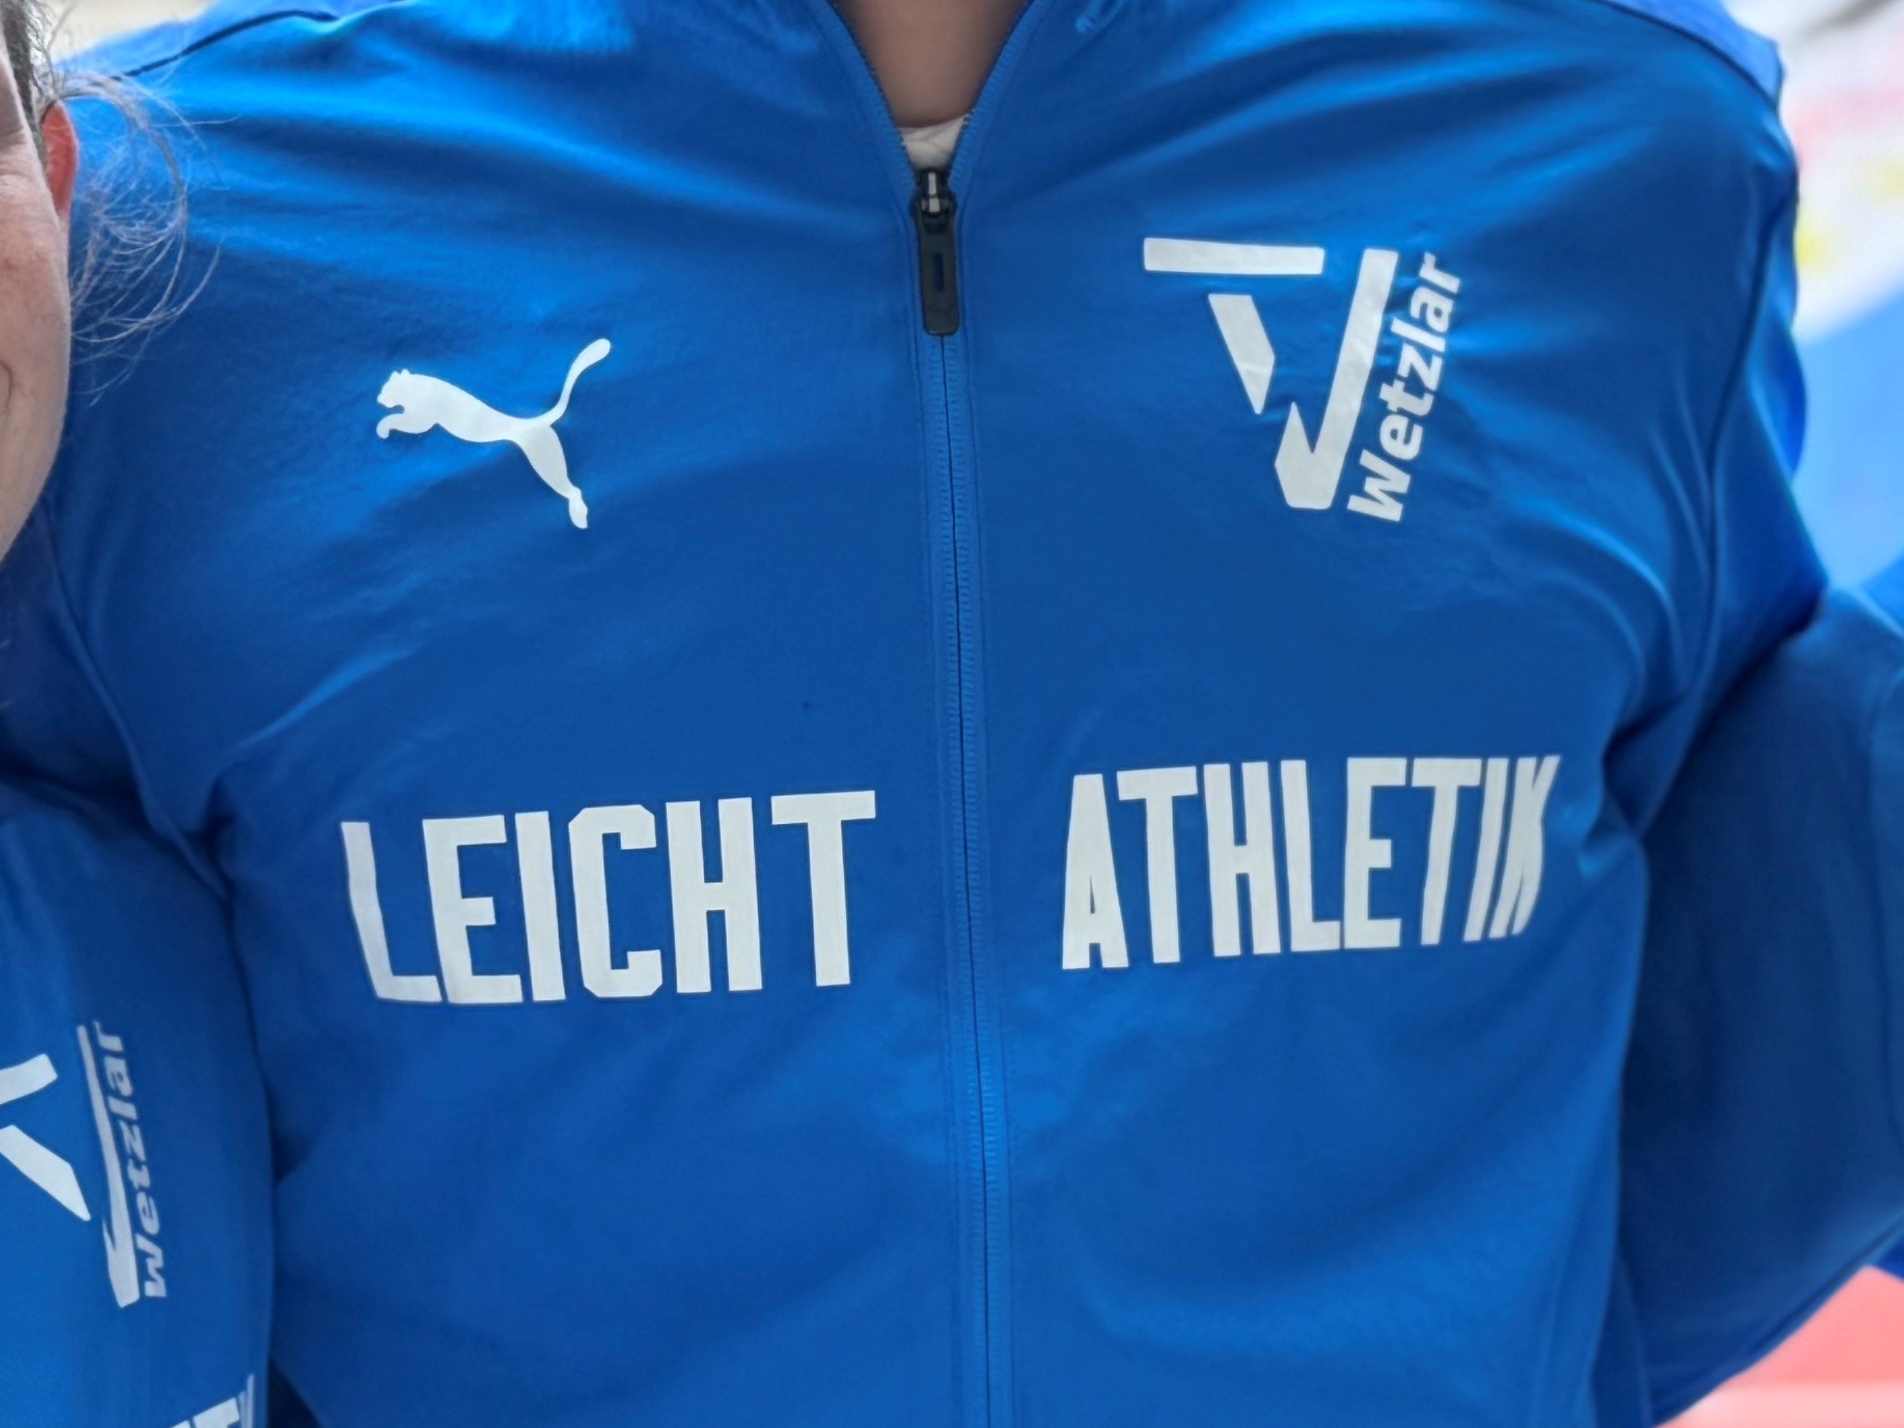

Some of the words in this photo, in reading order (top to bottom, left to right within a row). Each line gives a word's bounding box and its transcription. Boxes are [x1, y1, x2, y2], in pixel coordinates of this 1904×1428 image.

[1347, 251, 1461, 522] Wetzlar
[341, 790, 876, 1004] LEICHT
[1062, 755, 1561, 969] ATHLETIK
[92, 1020, 166, 1298] Wetzlar
